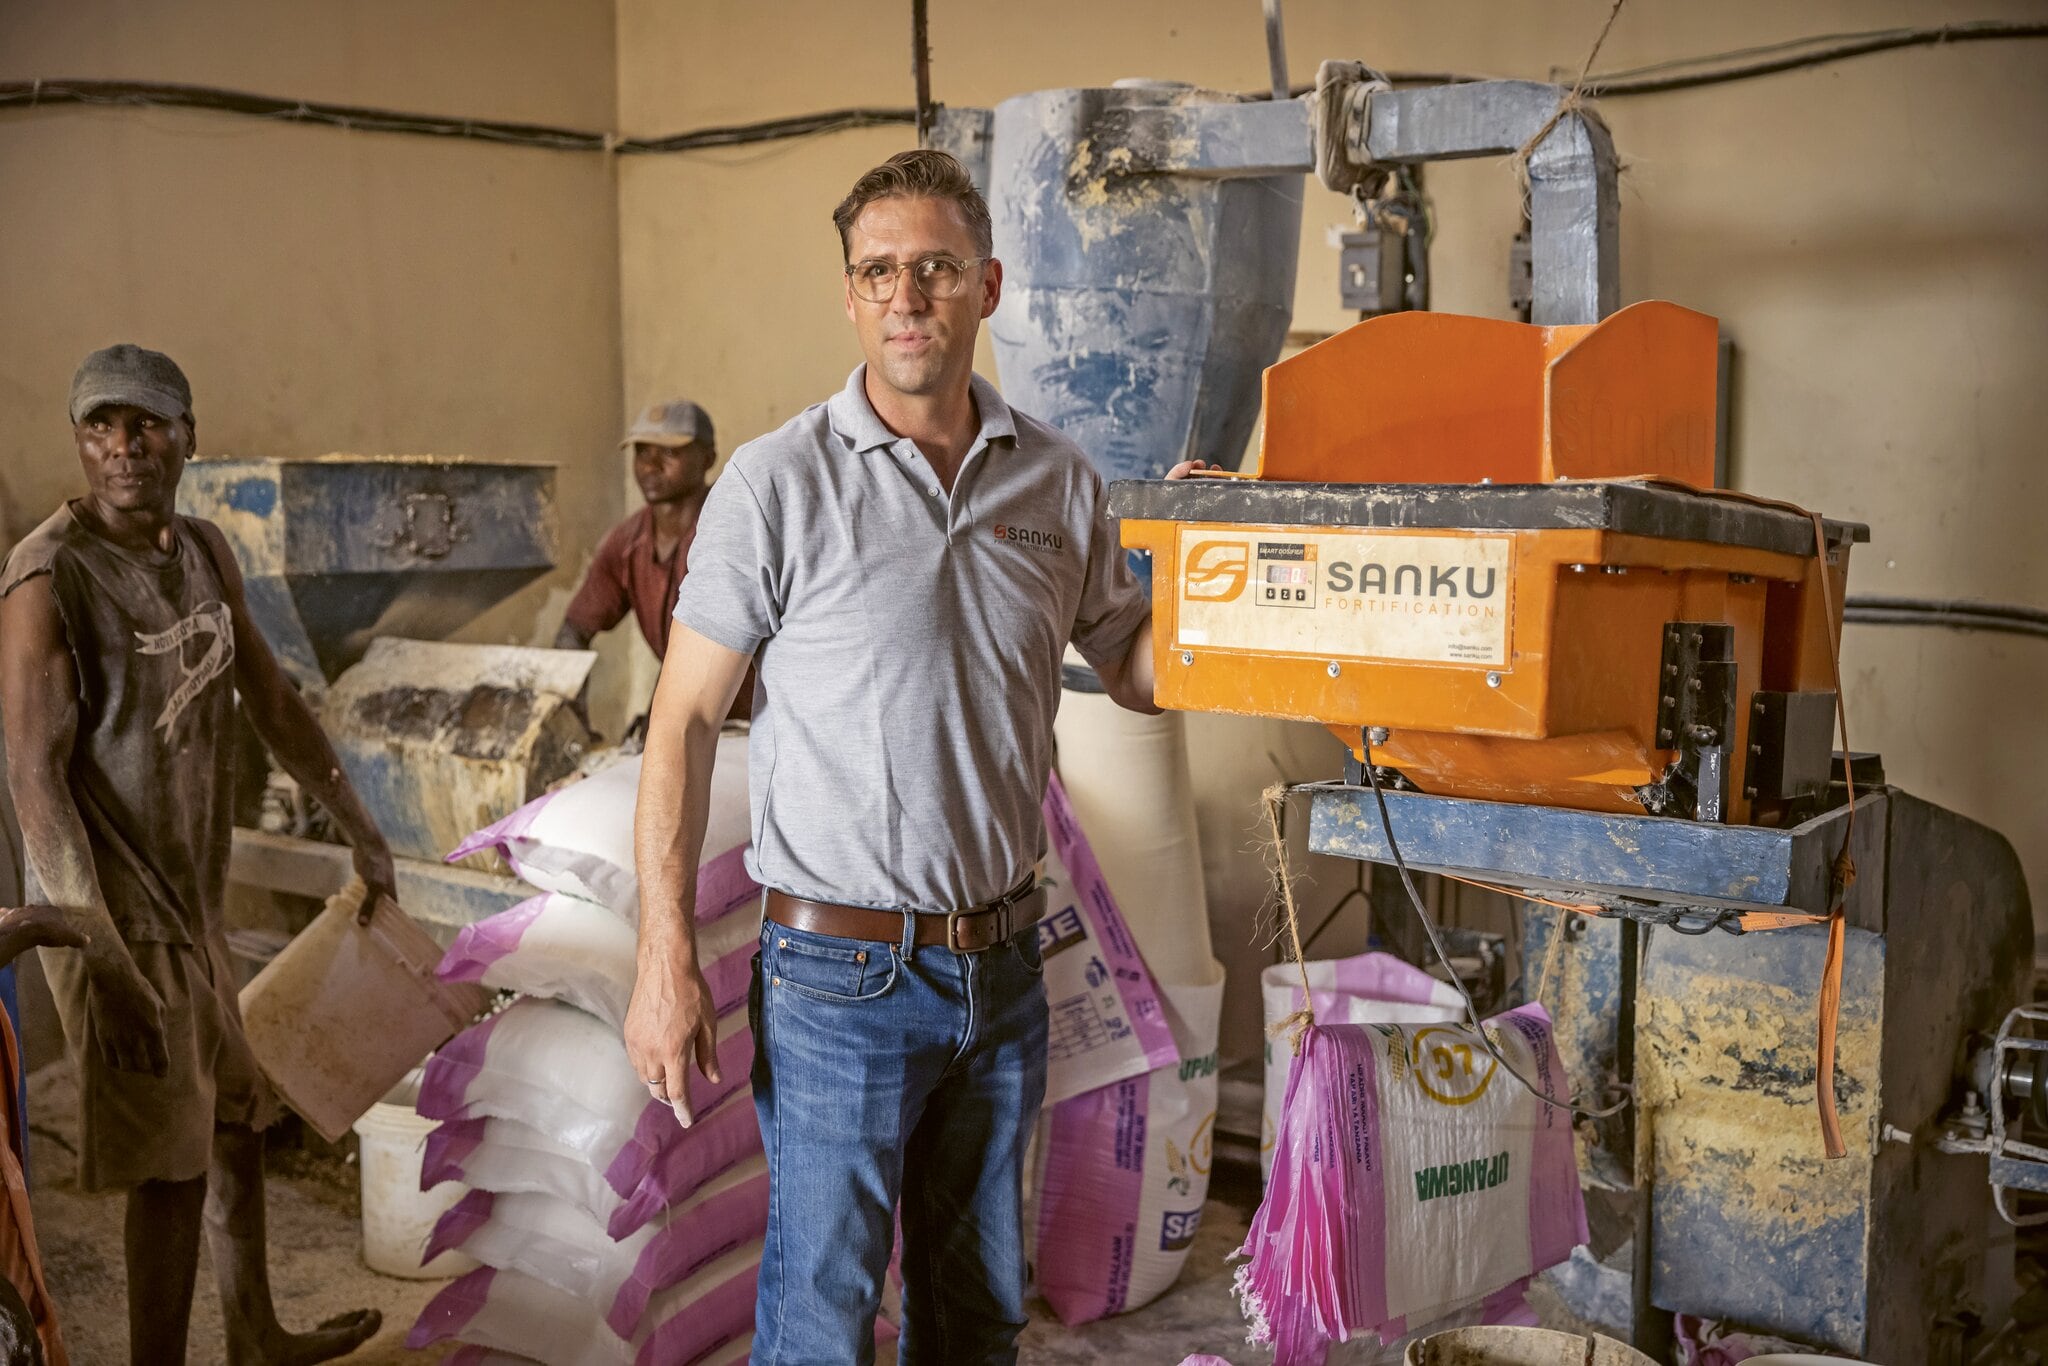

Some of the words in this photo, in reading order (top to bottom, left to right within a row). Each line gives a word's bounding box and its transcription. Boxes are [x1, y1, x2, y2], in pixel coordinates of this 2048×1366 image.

[1008, 526, 1063, 549] SANKU
[1326, 561, 1496, 599] SANKU
[1325, 597, 1495, 618] FORTIFICATION
[1354, 1120, 1362, 1164] TANZANIA
[1415, 1150, 1510, 1202] UPANGWA
